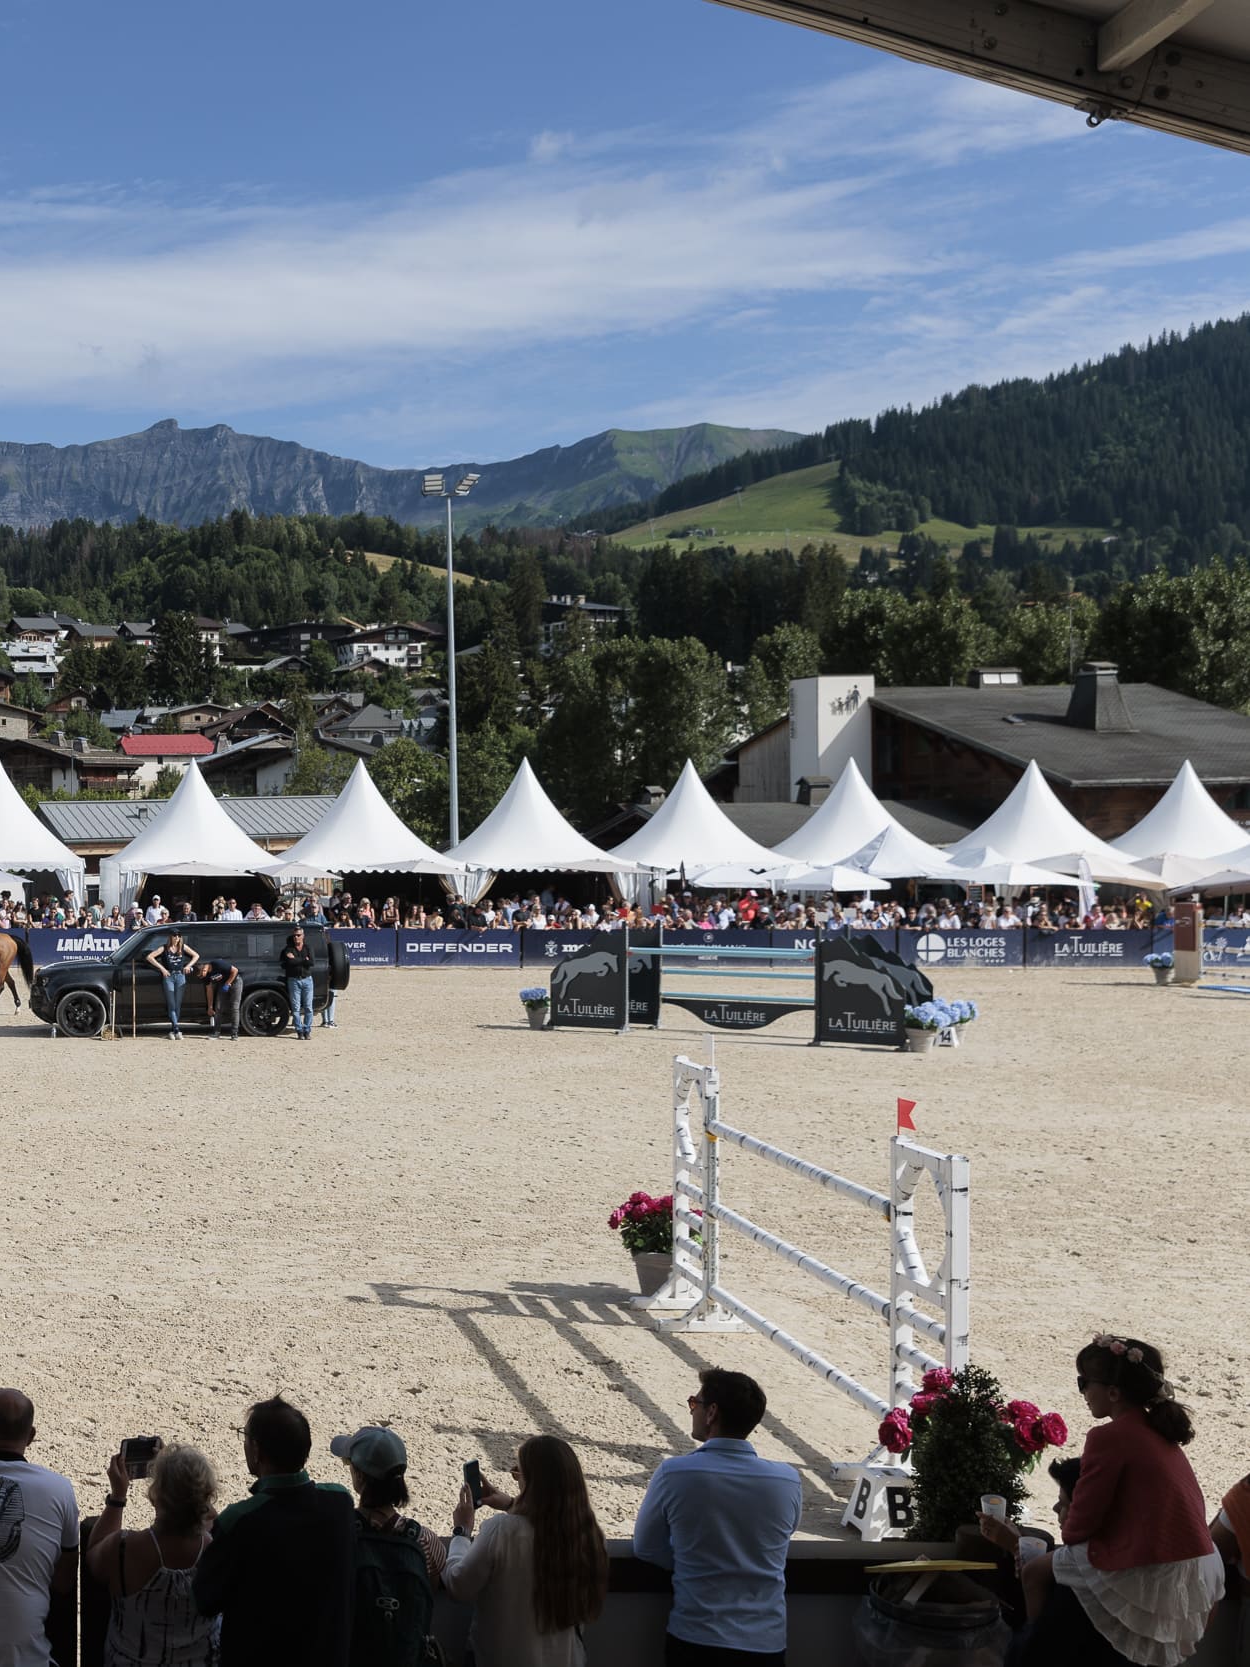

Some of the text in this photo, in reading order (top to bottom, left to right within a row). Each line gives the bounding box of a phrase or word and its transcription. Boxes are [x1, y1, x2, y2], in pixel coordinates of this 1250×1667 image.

[56, 933, 120, 951] LAVAZZA
[947, 937, 1006, 947] LES LOGES
[406, 943, 513, 953] DEFENDER
[947, 948, 1006, 958] BLANCHES
[1054, 943, 1070, 953] LA
[557, 1004, 570, 1013] LA
[704, 1010, 719, 1019] LA
[829, 1017, 845, 1028] LA
[938, 1030, 951, 1043] 14
[853, 1477, 872, 1520] B
[886, 1486, 916, 1528] B
